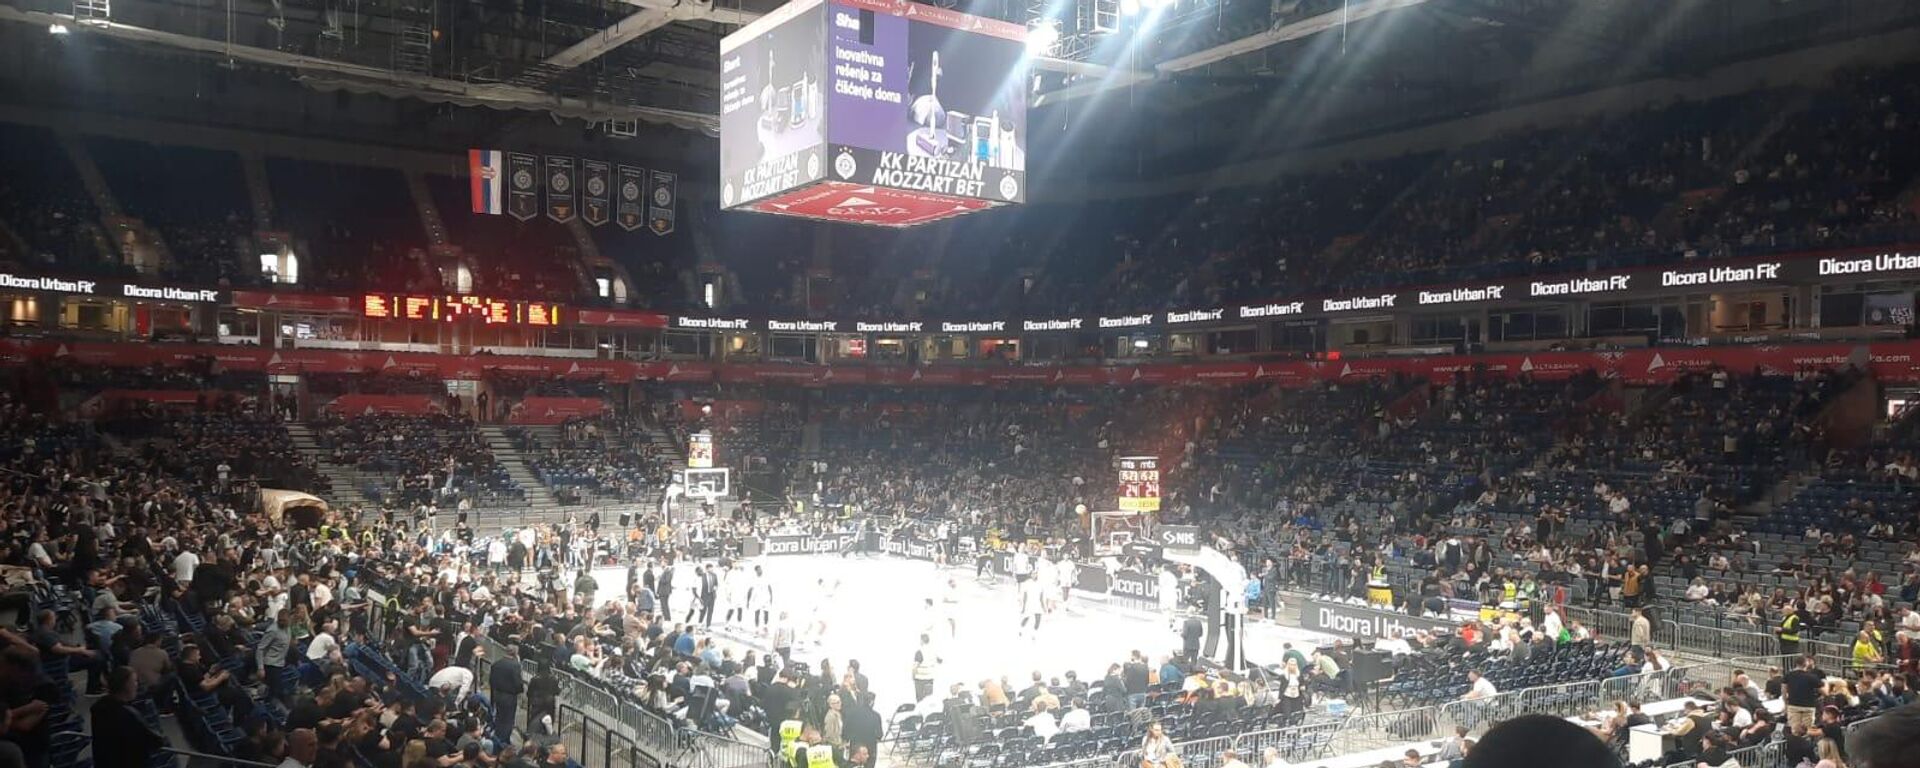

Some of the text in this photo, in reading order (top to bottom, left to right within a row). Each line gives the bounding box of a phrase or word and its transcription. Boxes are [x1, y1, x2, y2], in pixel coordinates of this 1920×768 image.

[835, 45, 885, 67] Inovativna
[871, 71, 883, 83] za
[874, 87, 902, 104] doma
[880, 151, 986, 180] KK PARTIZAN
[872, 167, 986, 198] MOZZART BET
[1819, 259, 1872, 275] Dicora
[0, 274, 39, 288] Dicora
[40, 277, 77, 291] Urban
[1662, 271, 1707, 286] Dicora
[1709, 267, 1754, 283] Urban
[124, 285, 161, 298] Dicora
[164, 287, 199, 301] Urban
[1531, 282, 1568, 296] Dicora
[1571, 278, 1608, 293] Urban
[1419, 292, 1451, 304] Dicora
[1453, 287, 1485, 302] Urban
[1240, 306, 1265, 318] Dicora
[1266, 304, 1290, 316] Urban
[1323, 299, 1351, 312] Dicora
[1352, 296, 1380, 310] Urban
[679, 317, 707, 328] Dicora
[708, 318, 734, 329] Urban
[1099, 317, 1121, 327] Dicora
[1122, 316, 1142, 326] Urban
[1168, 312, 1189, 323] Dicora
[1190, 309, 1211, 321] Urban
[768, 320, 796, 330] Dicora
[797, 321, 822, 331] Urban
[856, 322, 883, 332] Dicora
[884, 322, 909, 332] Urban
[942, 322, 967, 332] Dicora
[968, 321, 992, 331] Urban
[1024, 320, 1048, 331] Dicora
[1048, 319, 1070, 330] Urban
[1145, 482, 1159, 497] 24
[1176, 532, 1195, 545] NIS
[1320, 608, 1371, 636] Dicora
